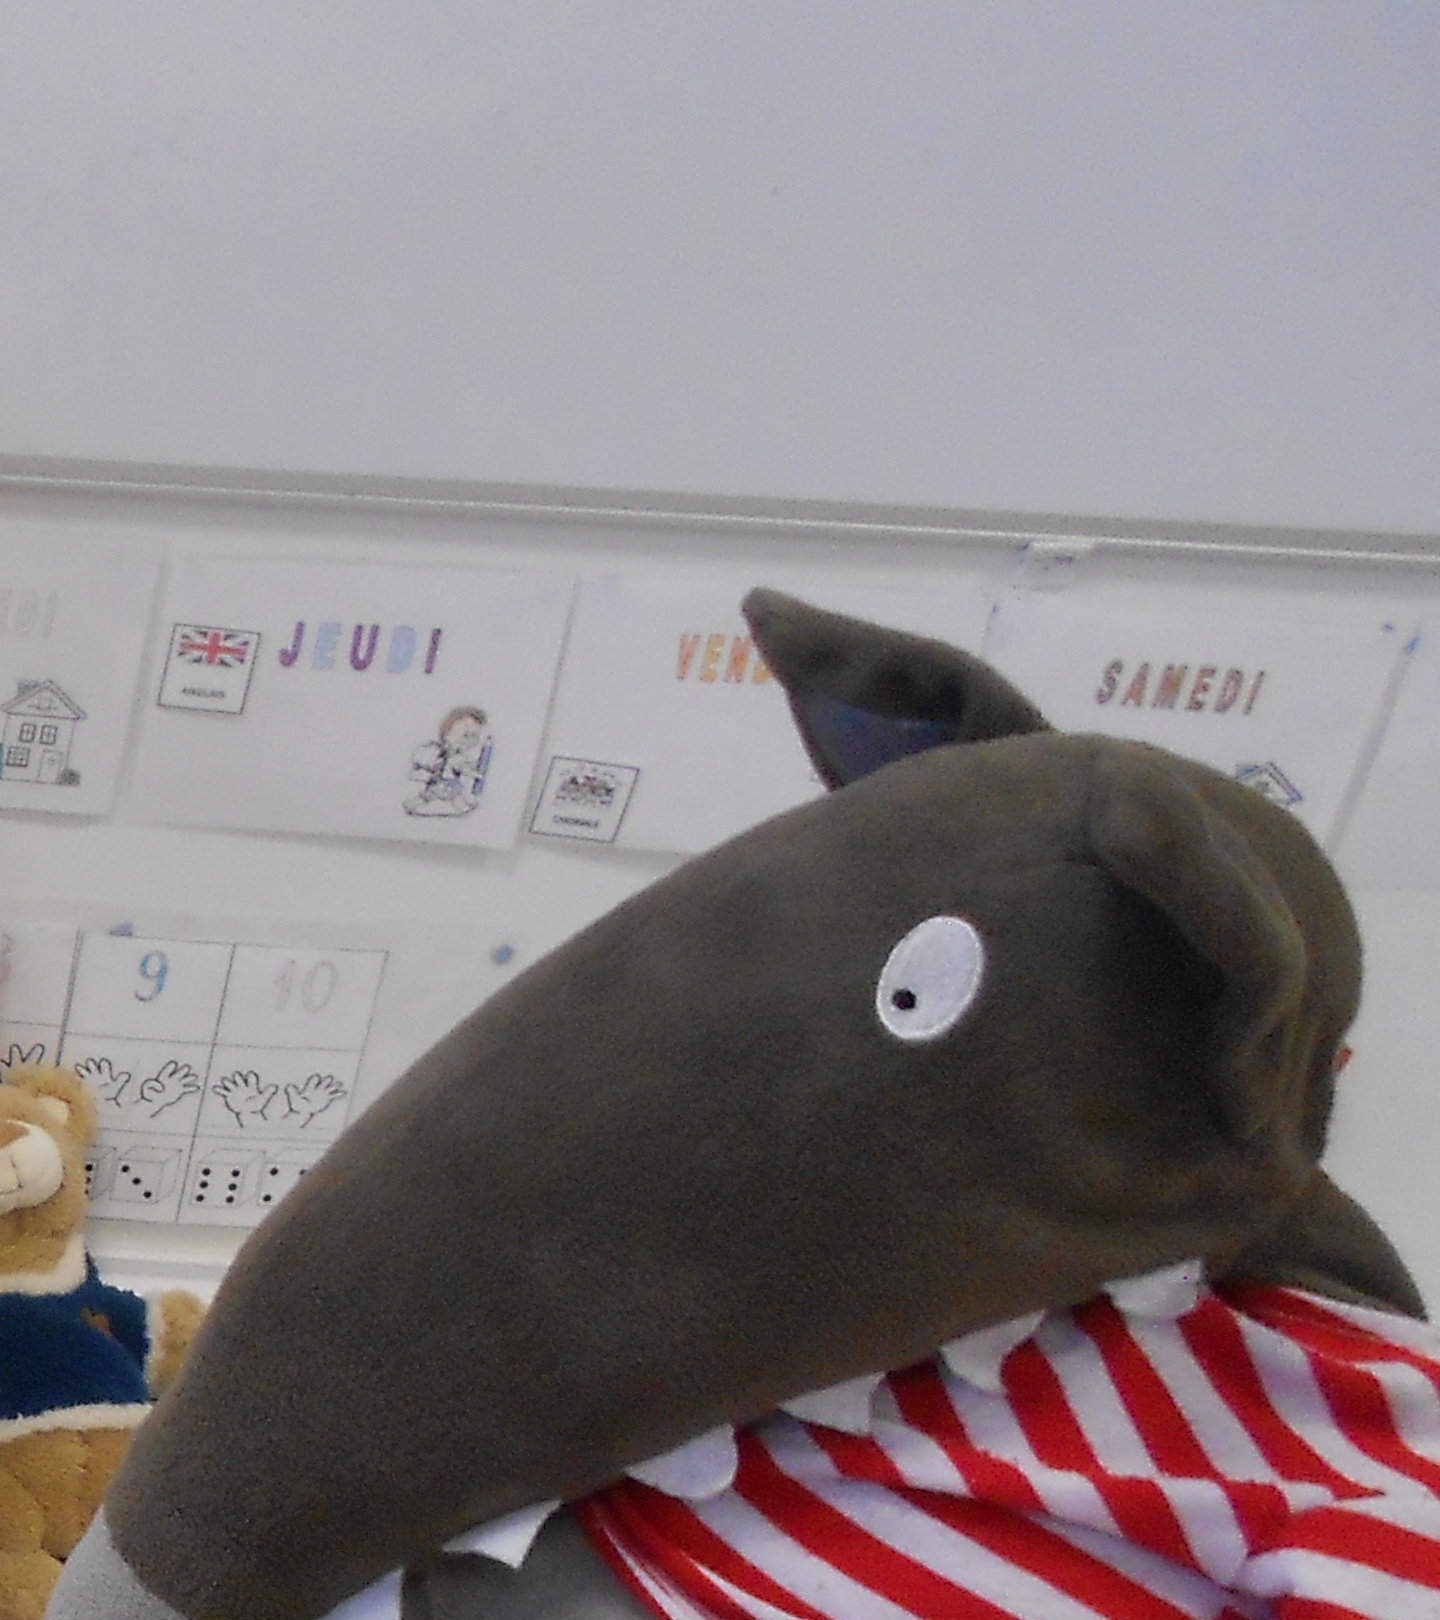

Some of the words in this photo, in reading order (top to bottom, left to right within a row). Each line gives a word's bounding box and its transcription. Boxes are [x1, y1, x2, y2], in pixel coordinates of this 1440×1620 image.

[278, 621, 442, 674] JEUDI
[1096, 659, 1265, 715] SAMEDI
[134, 950, 169, 1003] 9
[273, 958, 339, 1014] 10
